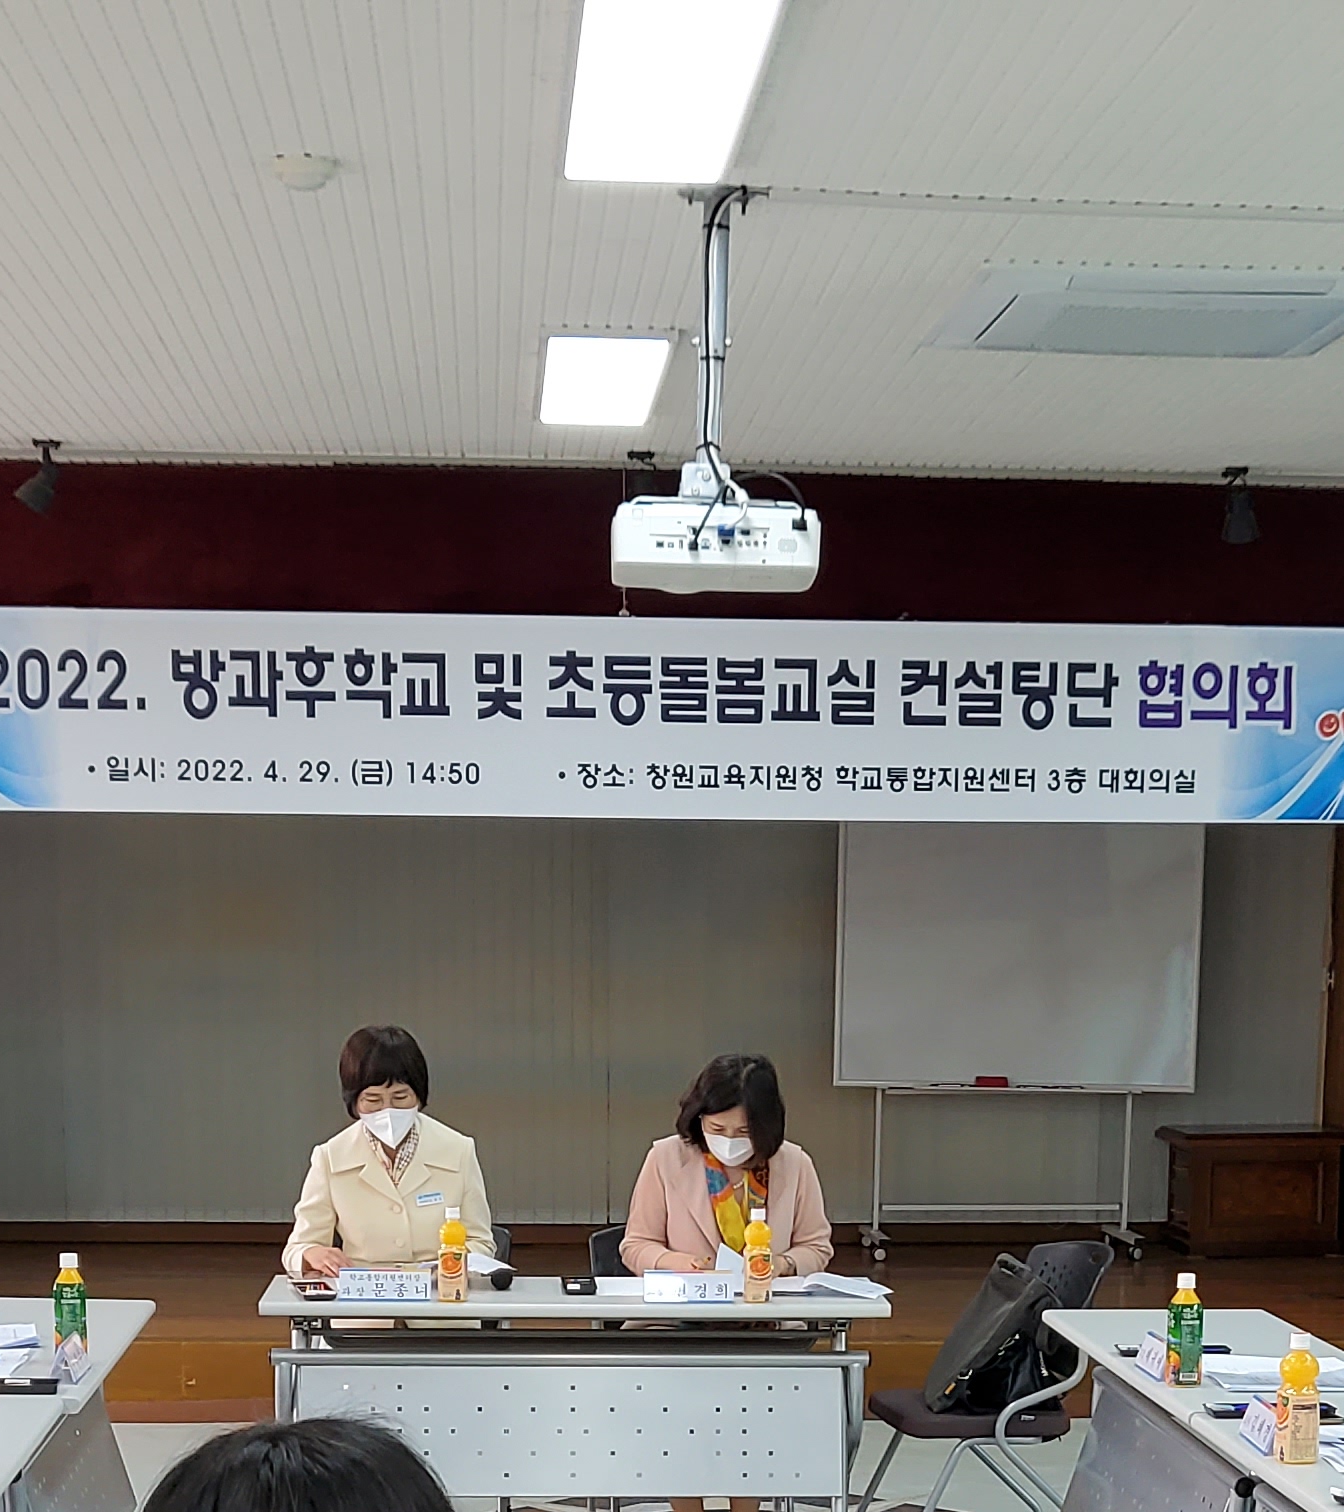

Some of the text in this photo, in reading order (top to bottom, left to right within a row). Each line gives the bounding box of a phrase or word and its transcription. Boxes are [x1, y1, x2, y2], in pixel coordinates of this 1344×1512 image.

[171, 645, 451, 720] 방과후학교
[474, 653, 522, 721] 및
[546, 650, 876, 726] 초등돌봄교실
[900, 660, 1120, 731] 컨설팅단
[1138, 659, 1293, 730] 협의회
[106, 756, 480, 787] 일시: 2022. 4. 29. (금) 14:50
[577, 763, 1196, 794] 장소: 창원교육지원청 학교통합지원센터 3층 대회의실
